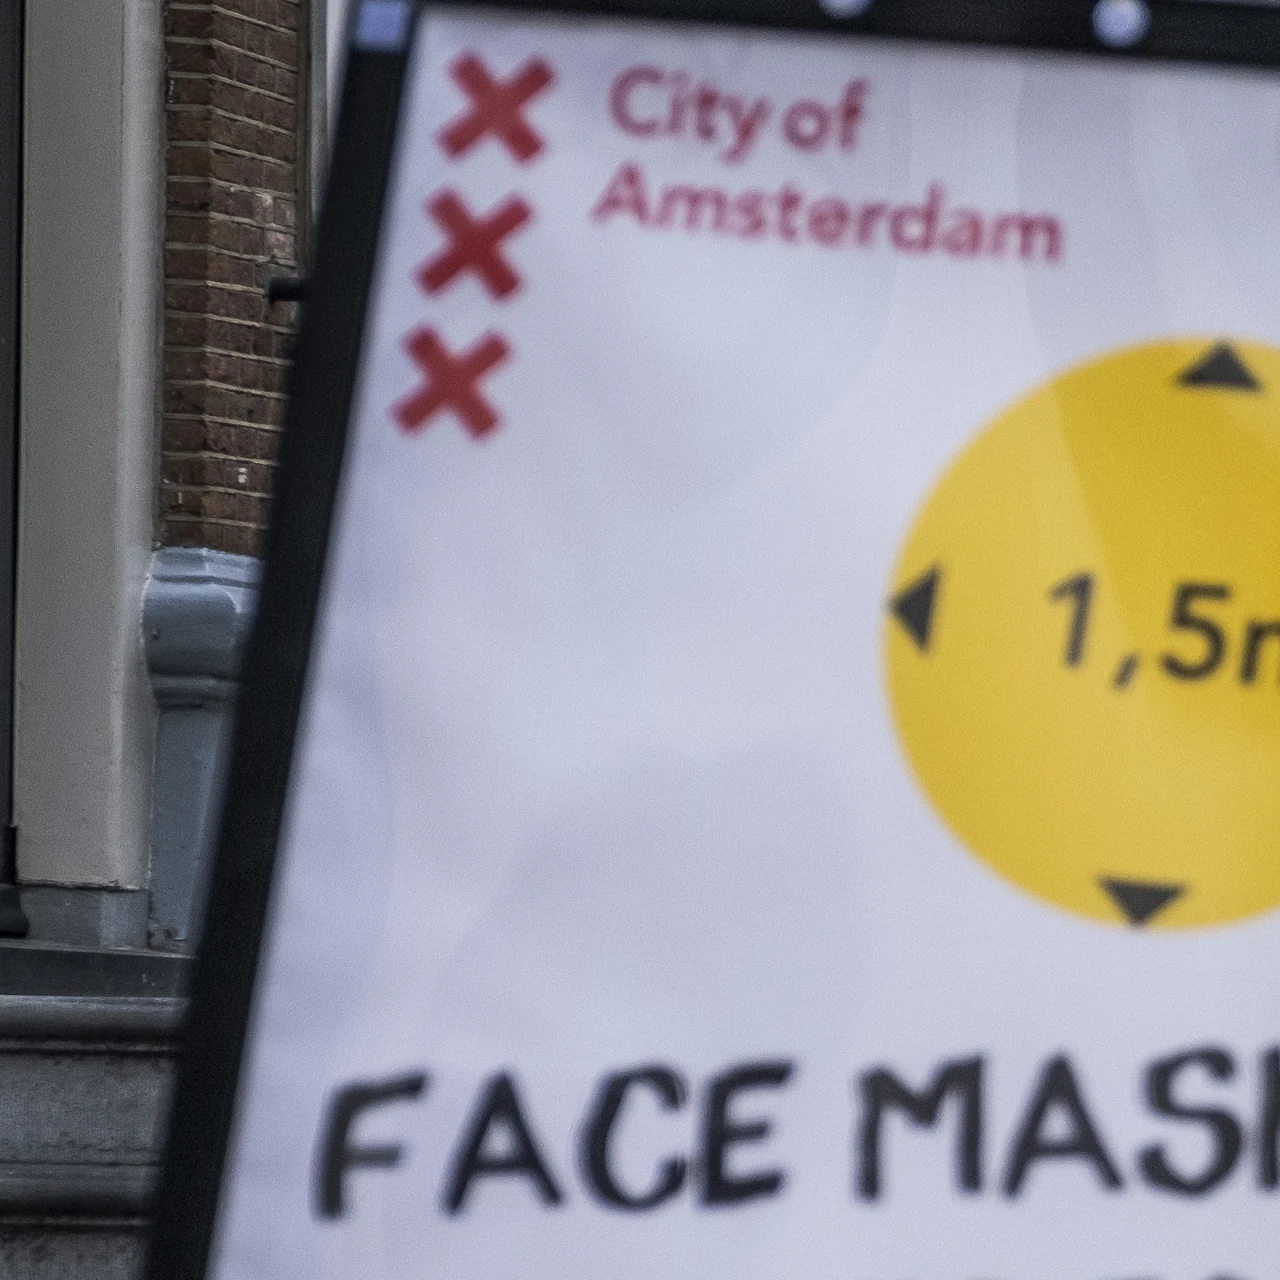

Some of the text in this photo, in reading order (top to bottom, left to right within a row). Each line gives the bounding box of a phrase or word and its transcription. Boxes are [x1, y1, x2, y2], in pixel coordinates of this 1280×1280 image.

[606, 64, 870, 167] City of
[590, 162, 1065, 264] Amsterdam
[312, 1060, 797, 1222] FACE
